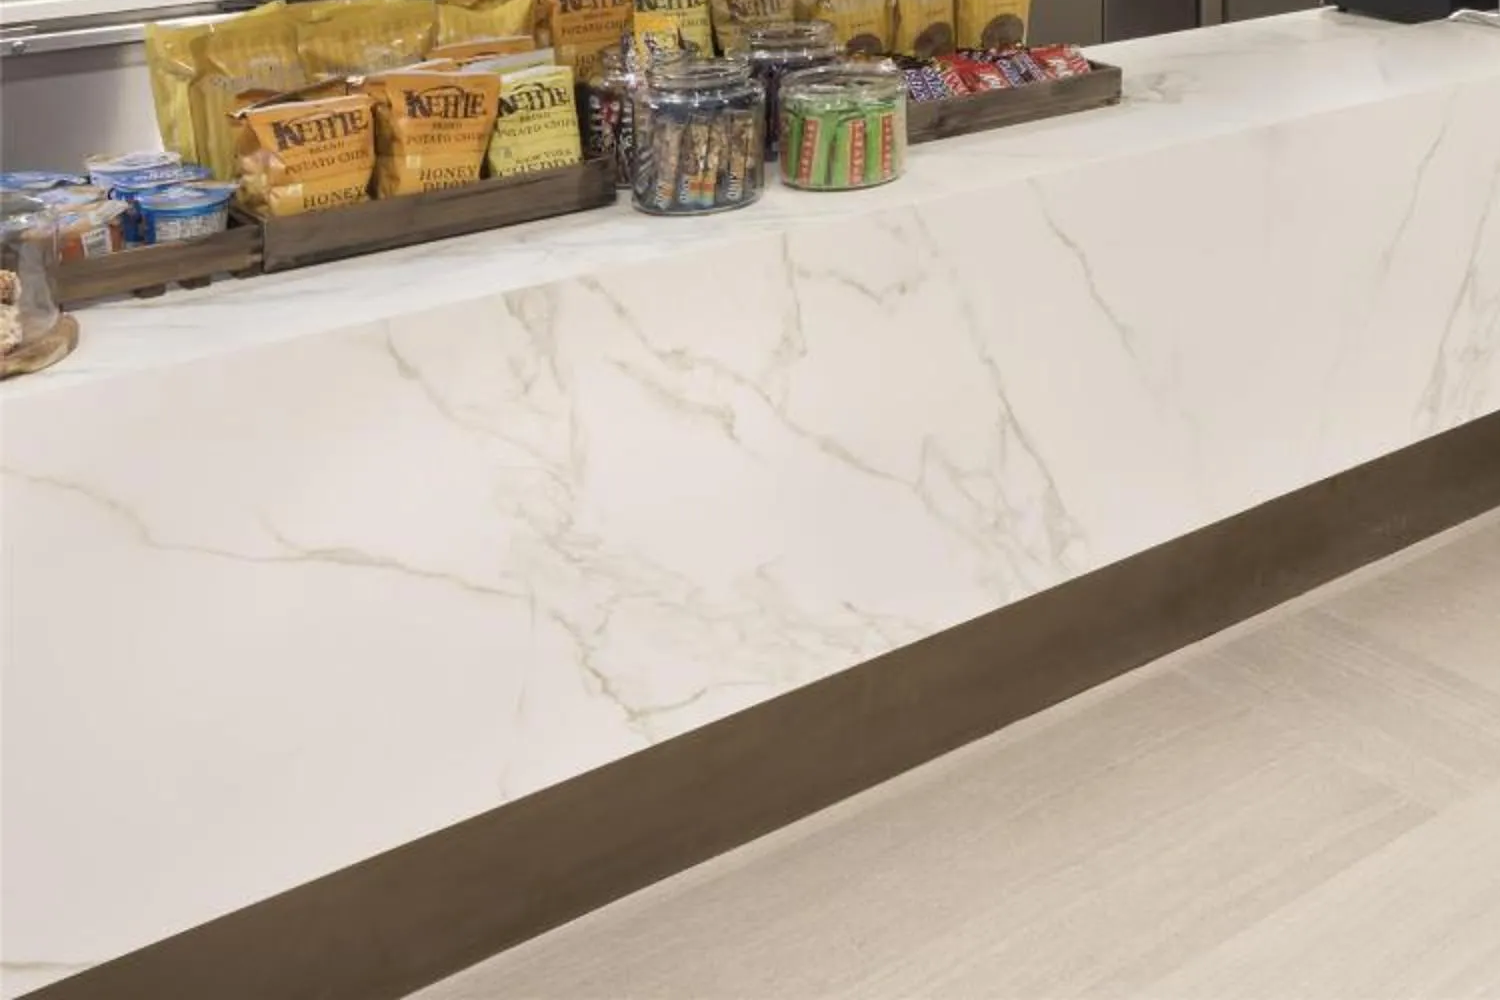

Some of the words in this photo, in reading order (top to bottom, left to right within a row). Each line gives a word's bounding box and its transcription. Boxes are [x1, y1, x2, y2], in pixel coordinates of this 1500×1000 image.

[403, 85, 488, 119] KETTLE
[497, 82, 572, 118] KETTLE
[271, 109, 370, 153] KETTLE
[420, 164, 478, 181] HONEY
[303, 183, 370, 209] HONEY
